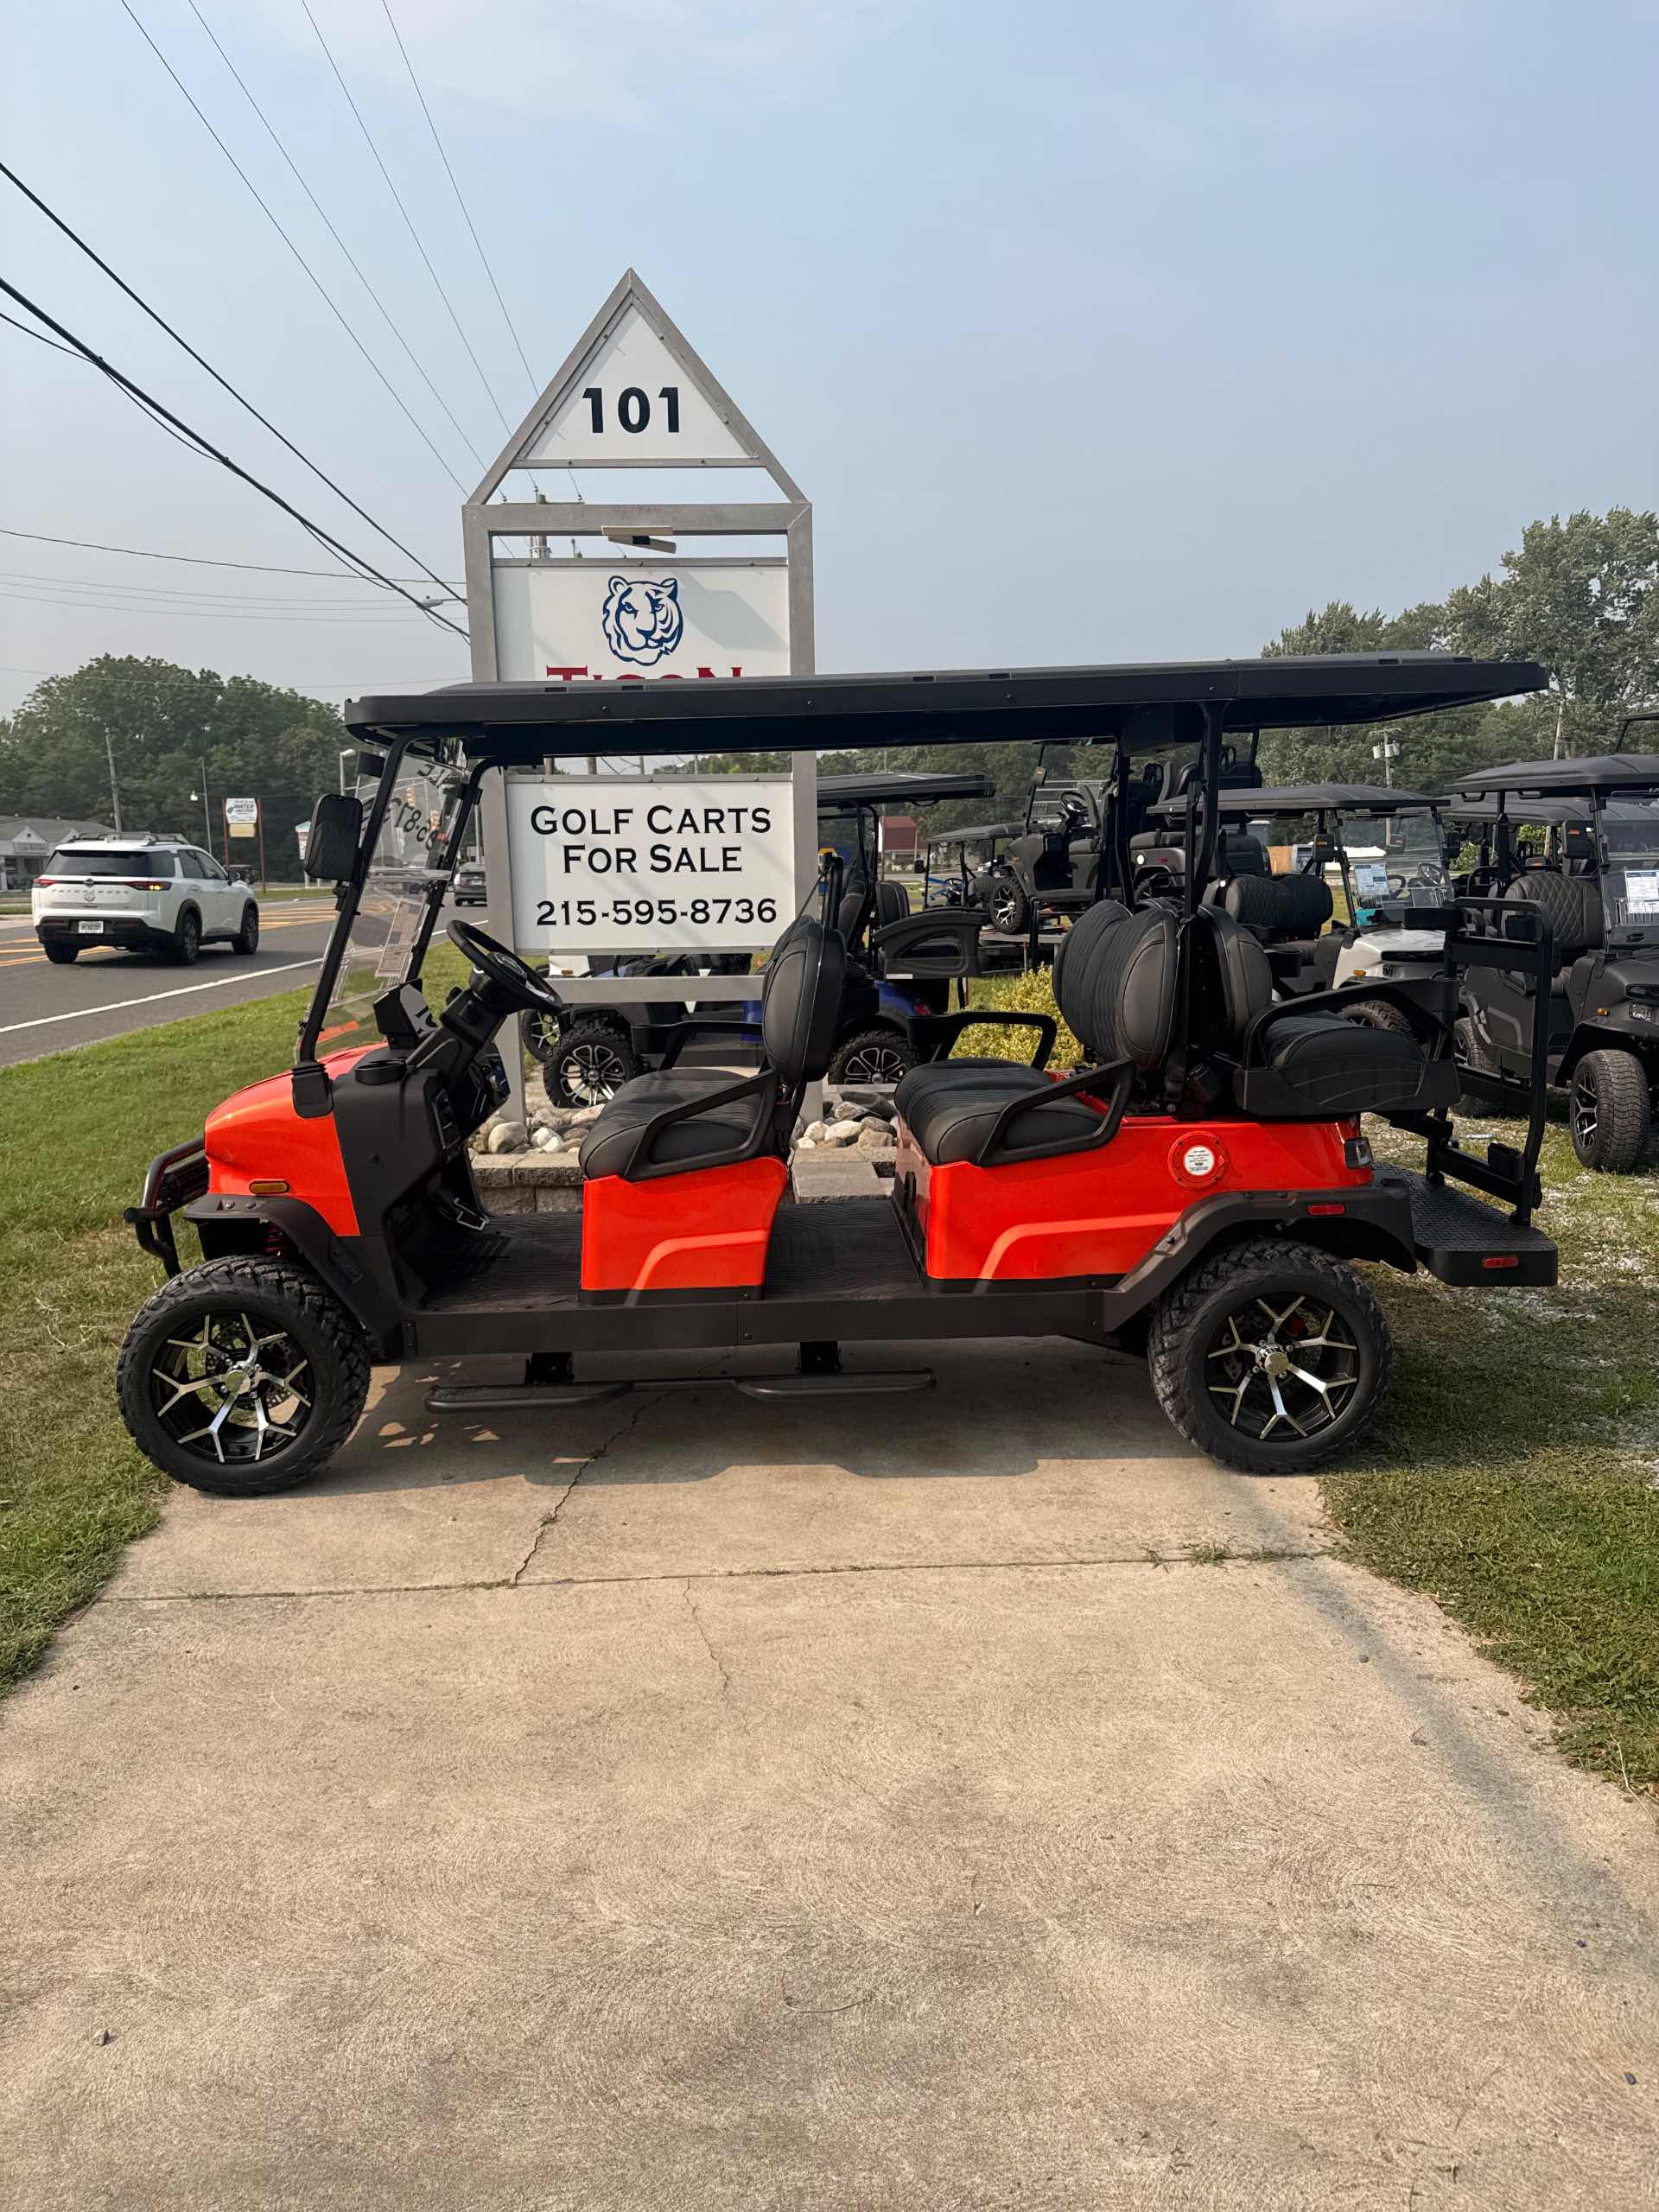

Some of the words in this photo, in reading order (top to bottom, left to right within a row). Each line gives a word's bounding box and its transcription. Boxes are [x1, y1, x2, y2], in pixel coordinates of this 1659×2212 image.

[582, 386, 681, 434] 101
[530, 804, 634, 836] GOLF
[646, 804, 772, 836] CARTS
[563, 843, 638, 874] FOR
[650, 843, 743, 874] SALE
[536, 898, 778, 926] 215-595-8736
